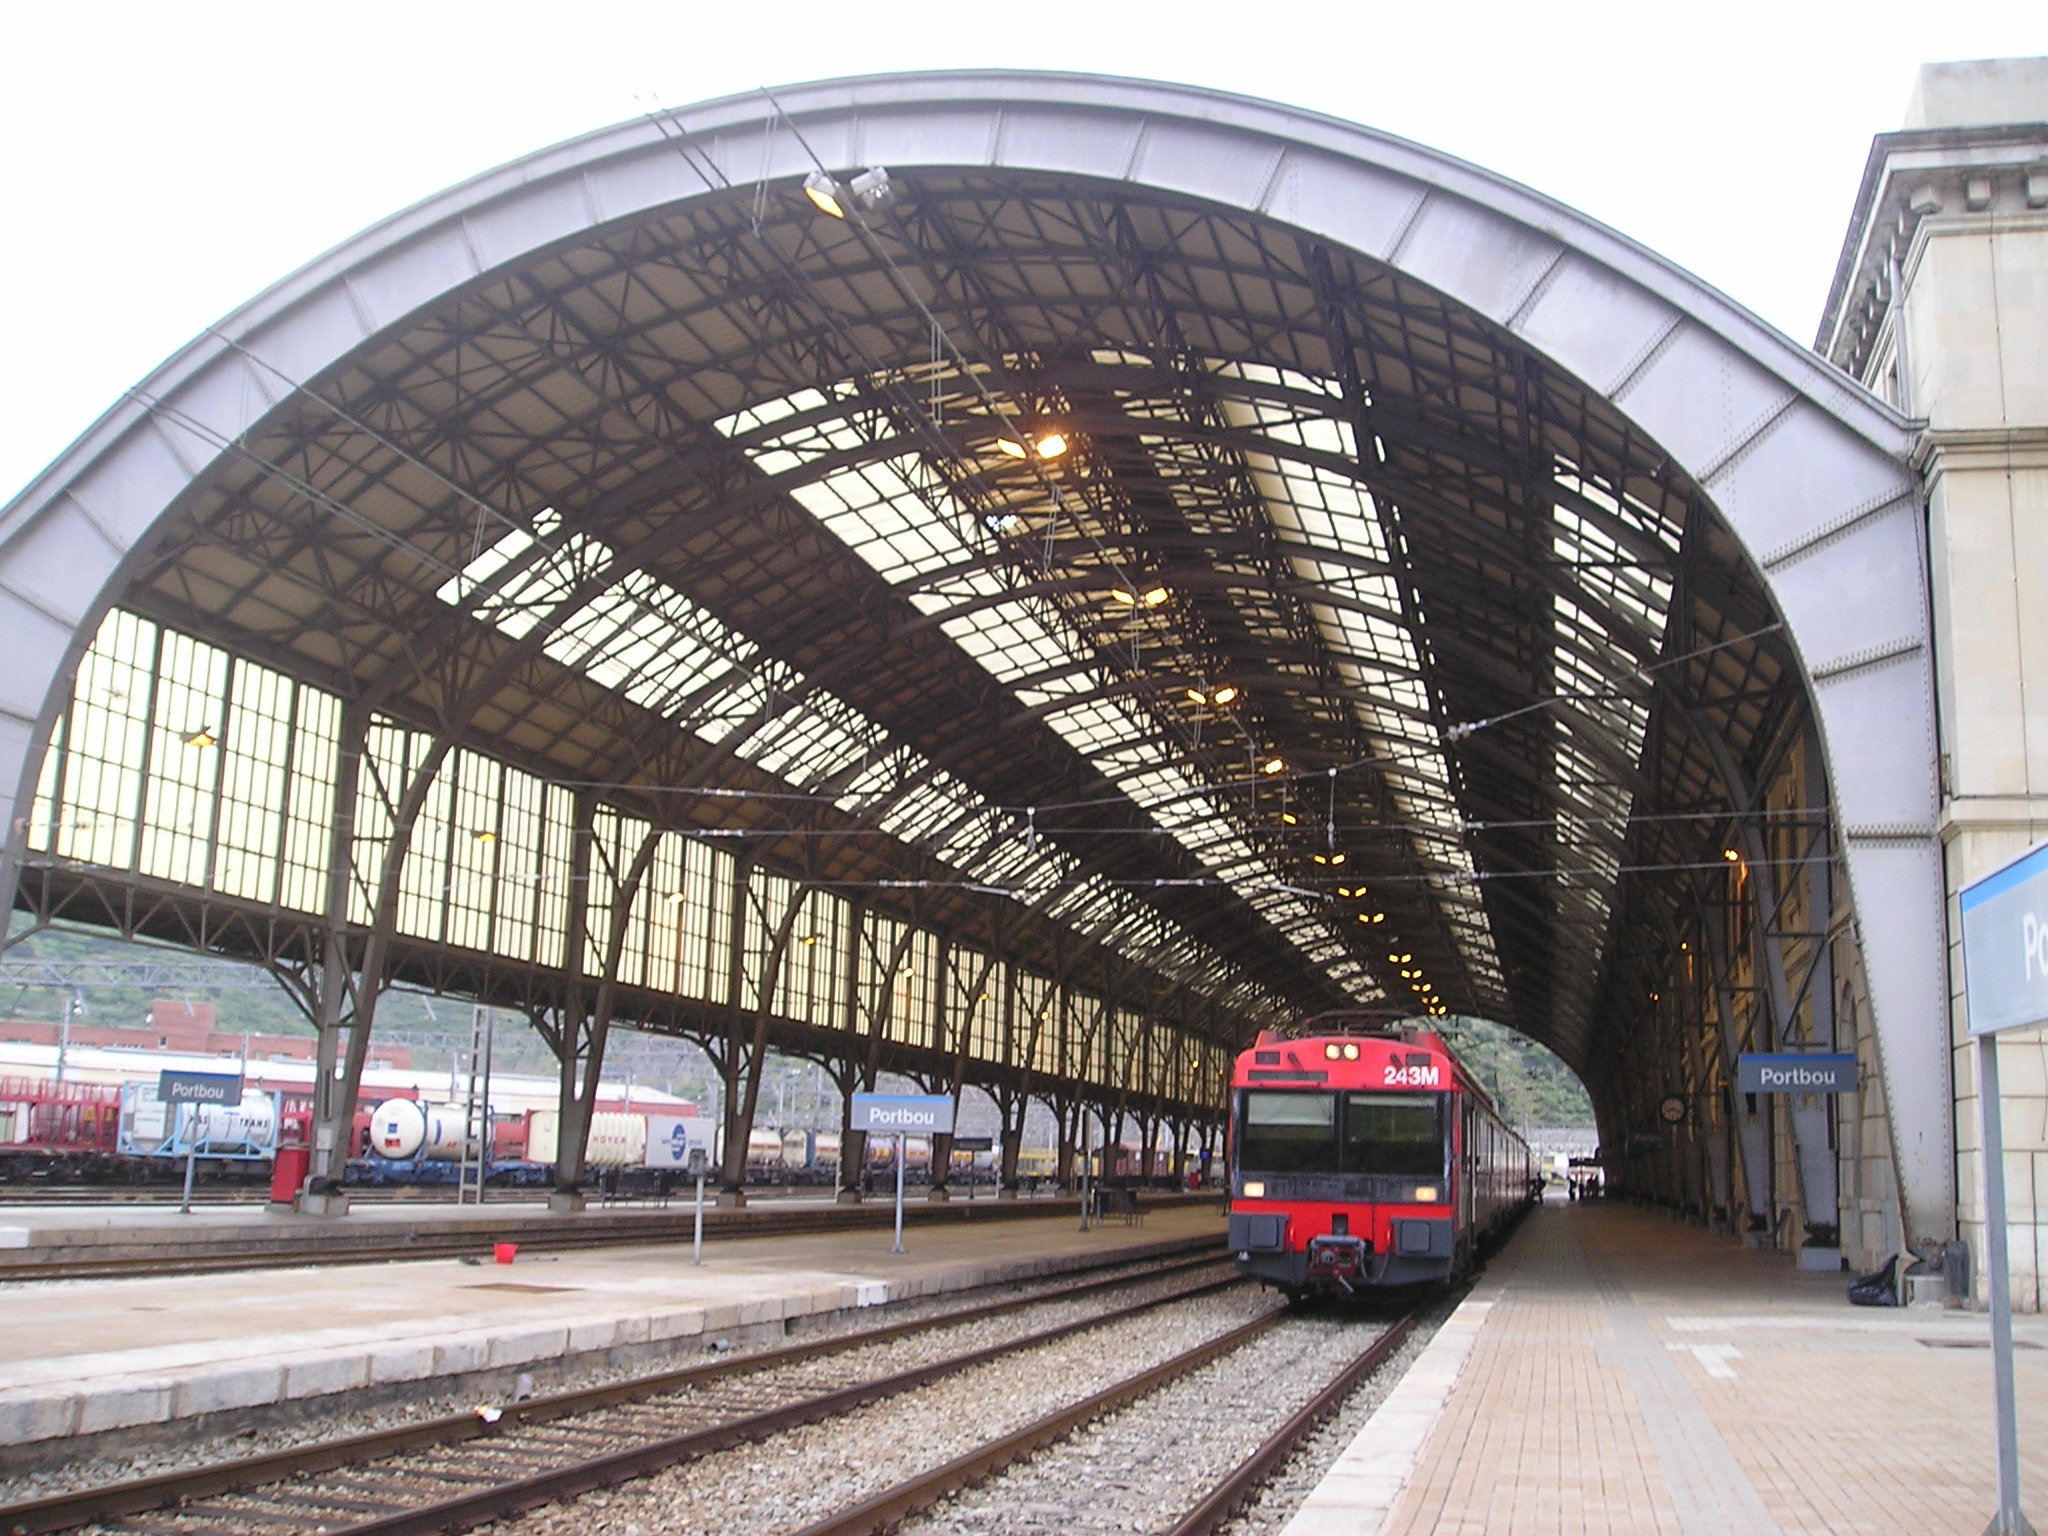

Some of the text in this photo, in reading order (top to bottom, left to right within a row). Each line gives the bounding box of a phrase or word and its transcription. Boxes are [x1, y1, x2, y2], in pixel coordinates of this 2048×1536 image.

[1384, 1065, 1439, 1086] 243M
[1760, 1066, 1836, 1086] Portbou
[171, 1081, 224, 1100] Portbou
[869, 1106, 935, 1126] Portbou
[592, 1135, 627, 1146] HOYER
